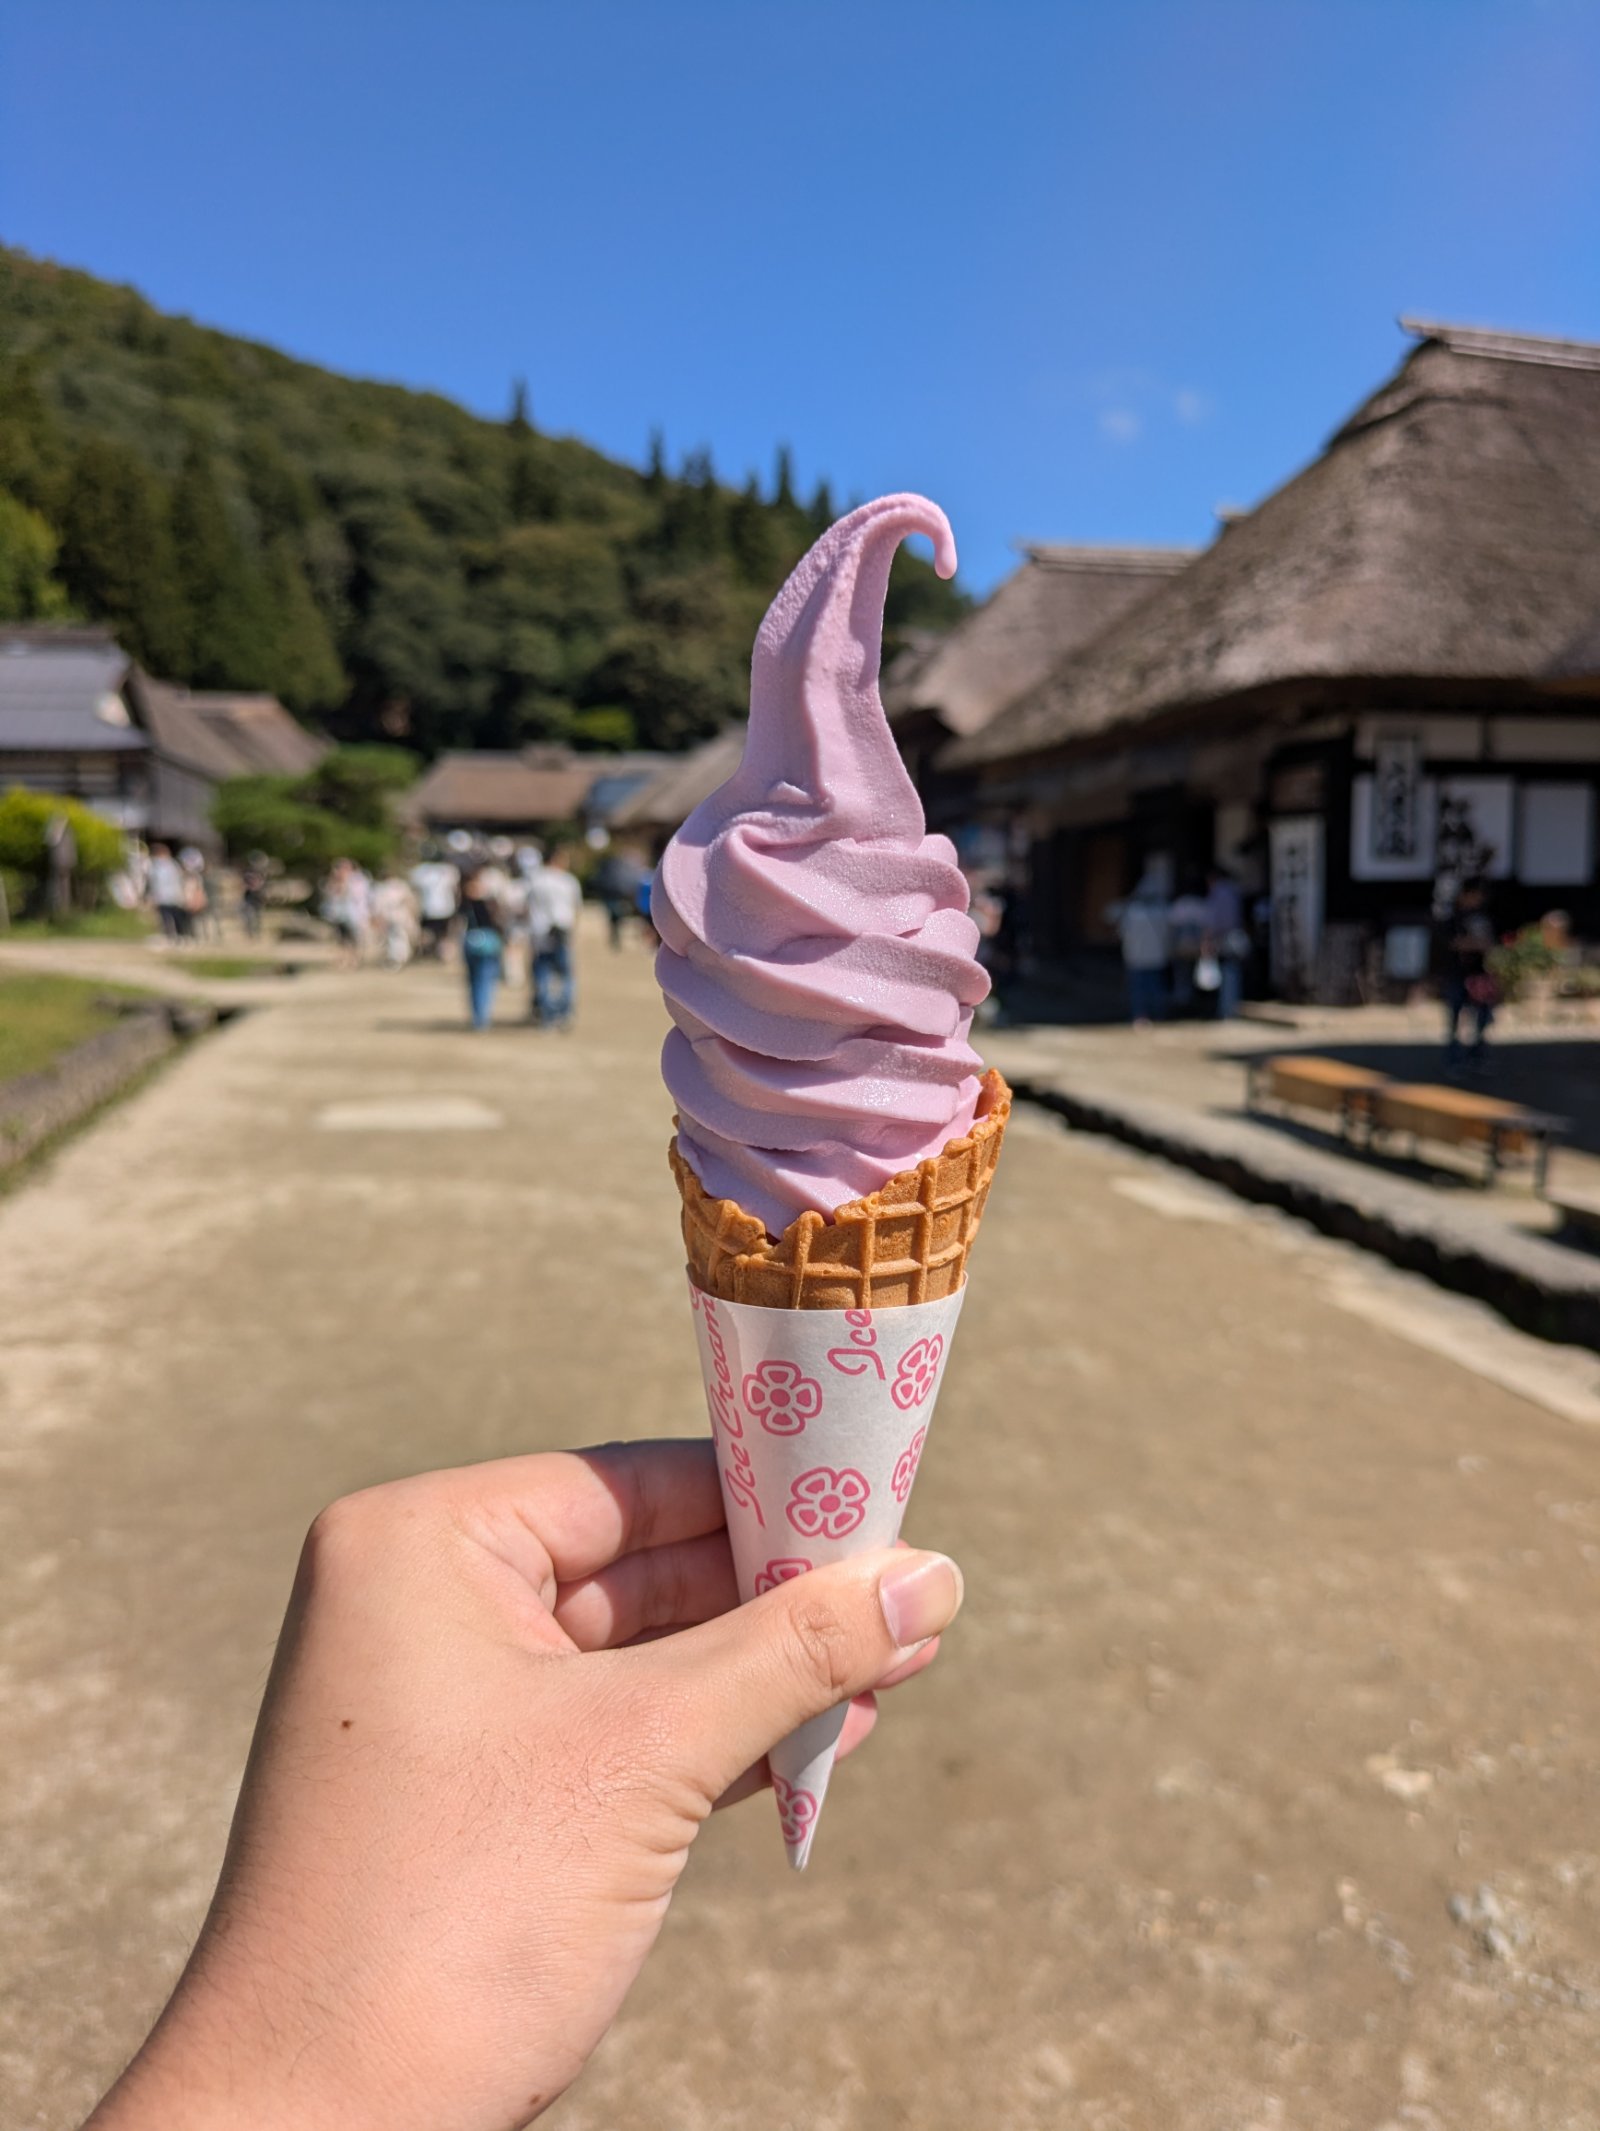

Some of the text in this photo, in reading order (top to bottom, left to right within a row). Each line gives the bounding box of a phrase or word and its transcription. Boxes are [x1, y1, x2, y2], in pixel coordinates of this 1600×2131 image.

[701, 1296, 766, 1529] Ice Cream
[827, 1309, 886, 1381] Ice
